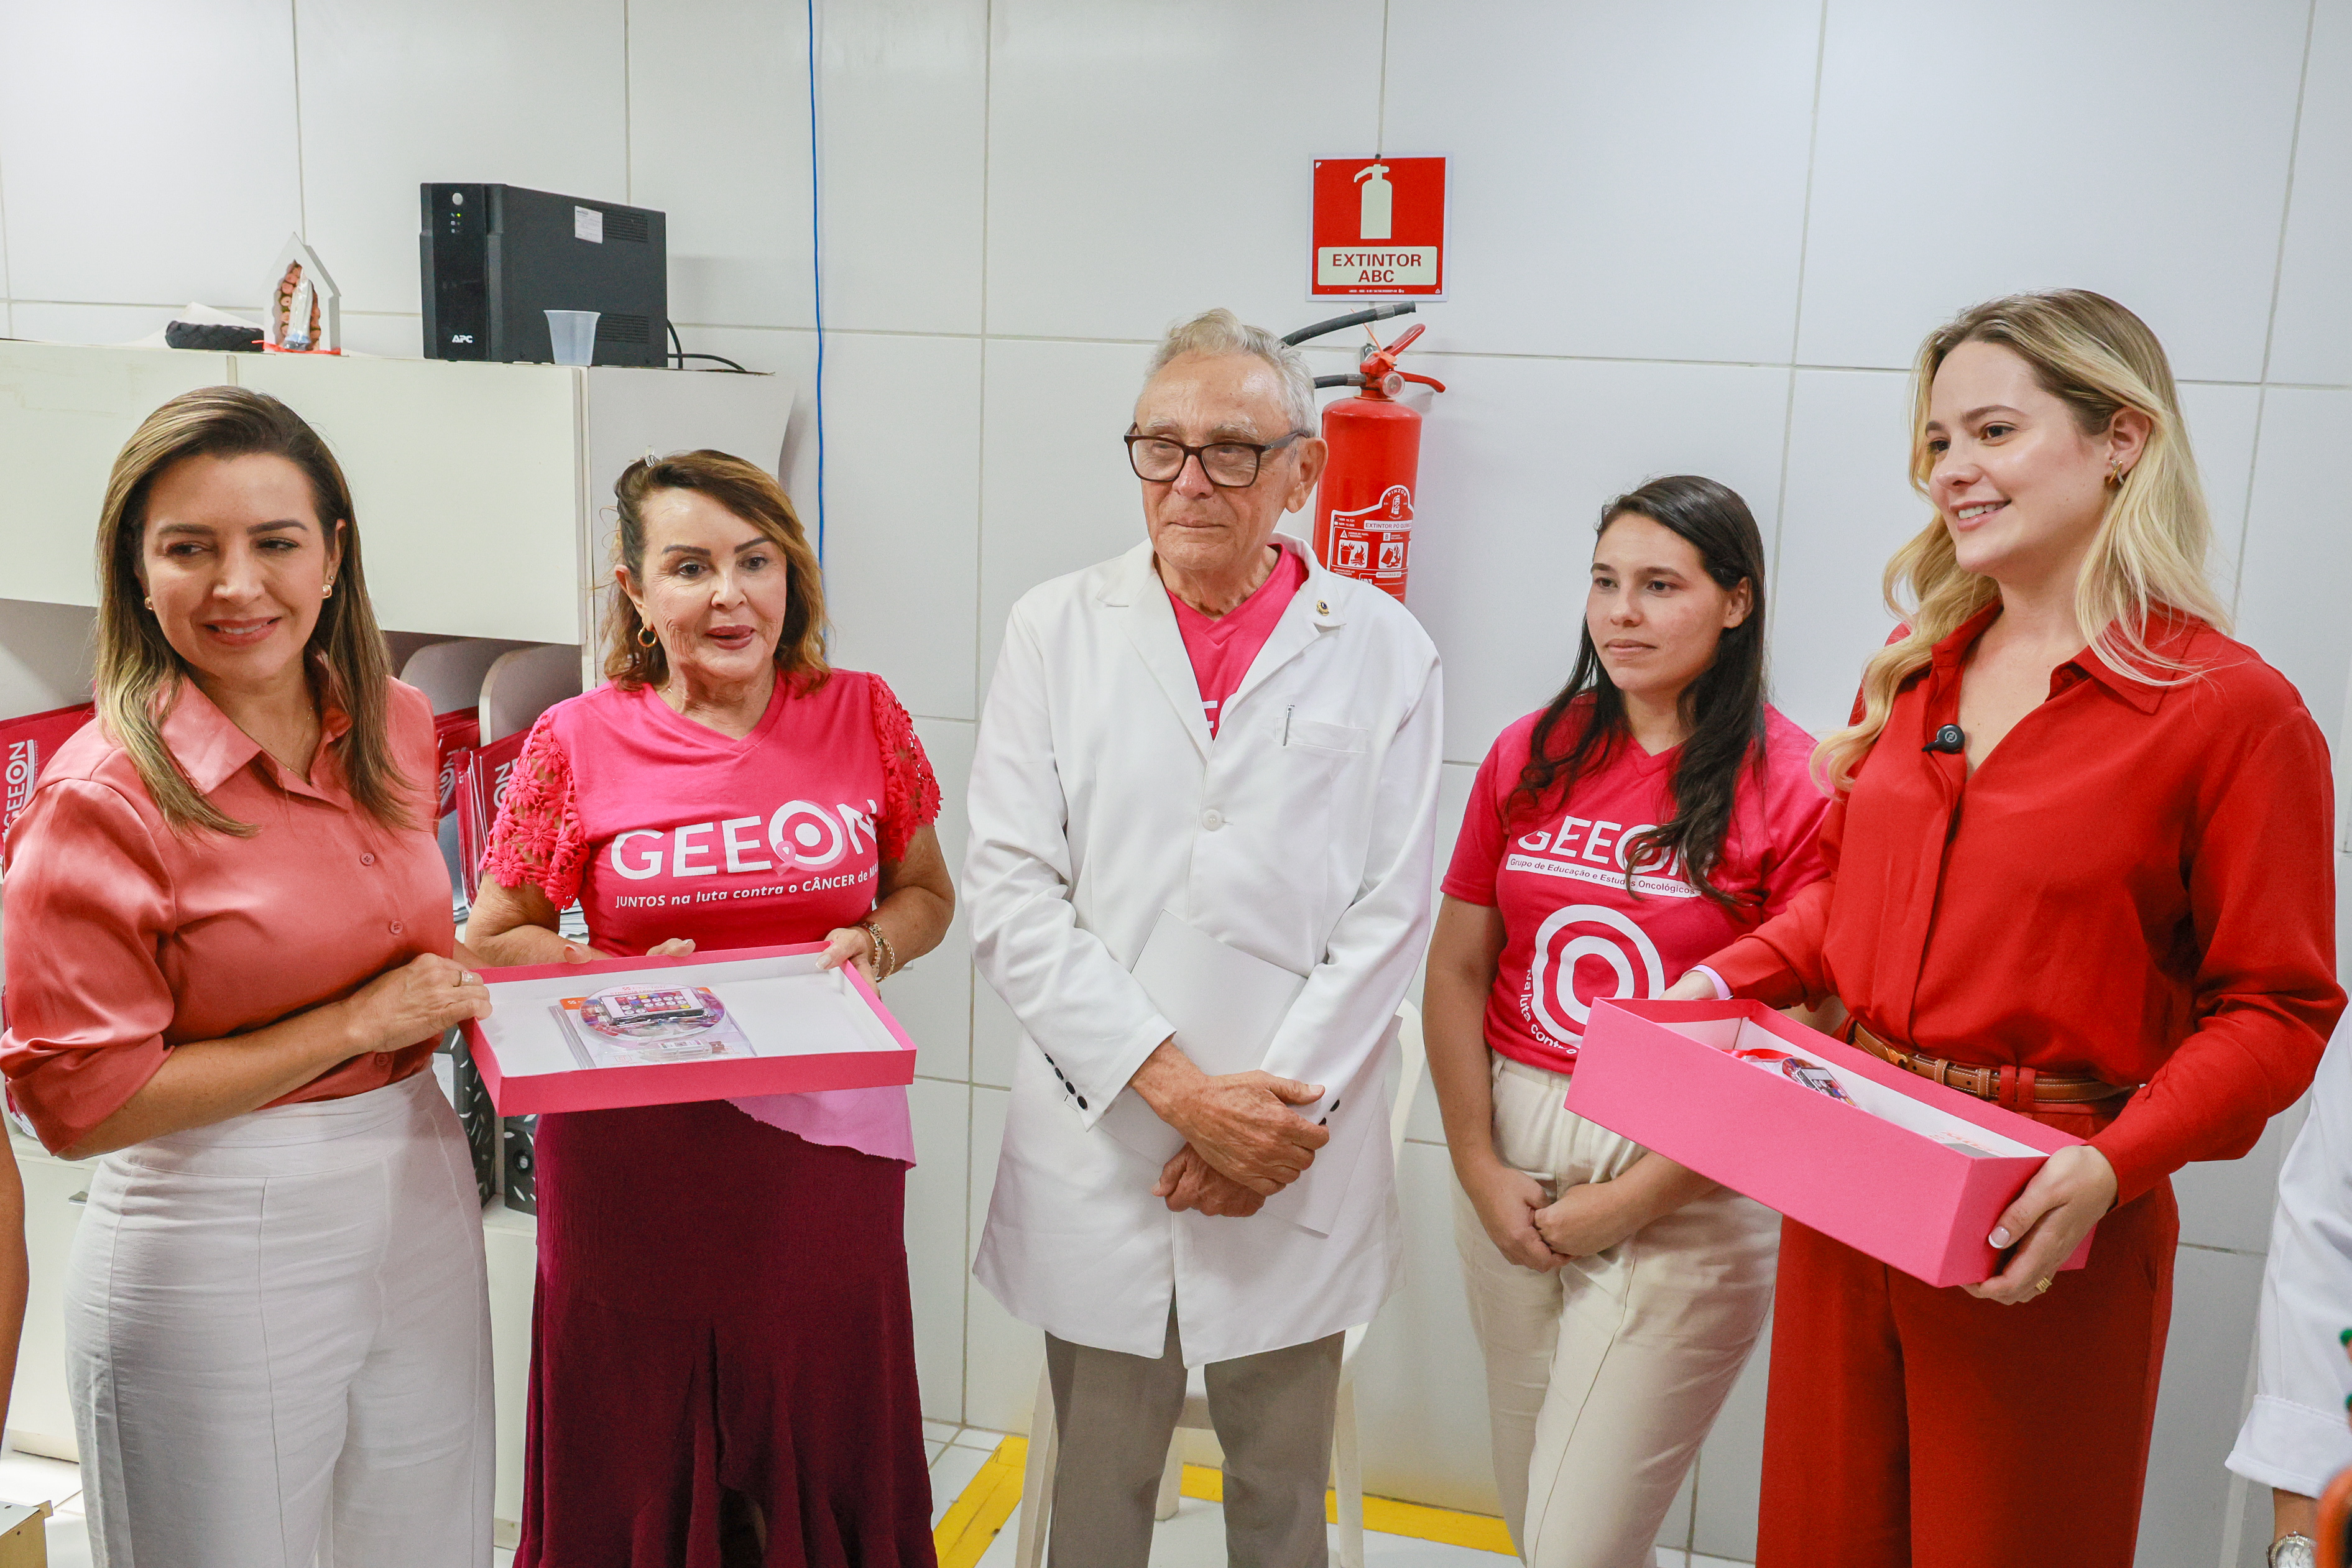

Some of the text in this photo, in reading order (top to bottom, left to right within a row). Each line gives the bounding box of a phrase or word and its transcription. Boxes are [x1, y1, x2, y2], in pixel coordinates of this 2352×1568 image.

[1332, 254, 1422, 267] EXTINTOR
[1358, 270, 1395, 283] ABC
[452, 334, 473, 343] APC
[1387, 489, 1407, 497] PINZON
[611, 799, 877, 880] GEEON
[1510, 859, 1532, 867] Grupo
[1547, 864, 1590, 877] Educação
[1600, 874, 1636, 887] Estuds
[1638, 880, 1695, 894] Oncológicos
[615, 895, 666, 908] JUNTOS
[671, 895, 691, 905] na
[696, 891, 727, 903] luta
[732, 885, 784, 898] contra
[788, 884, 798, 893] o
[802, 874, 855, 892] CÂNCER
[857, 871, 868, 883] de
[1520, 994, 1533, 1022] luta
